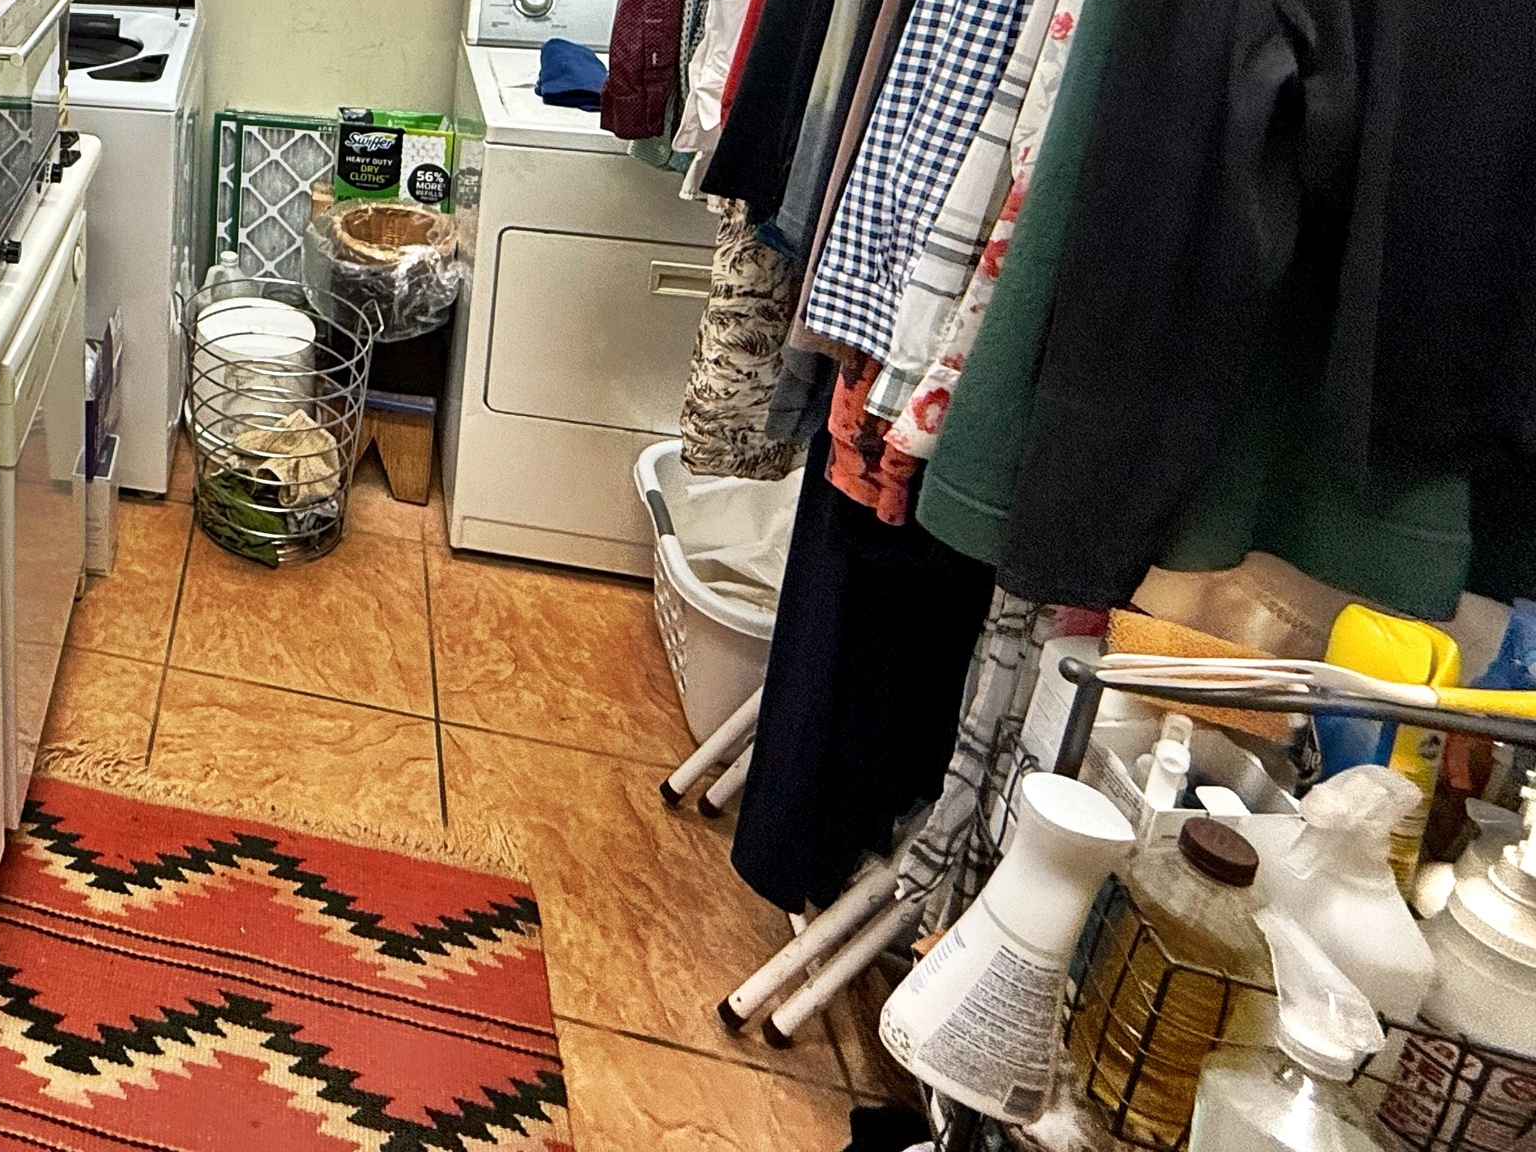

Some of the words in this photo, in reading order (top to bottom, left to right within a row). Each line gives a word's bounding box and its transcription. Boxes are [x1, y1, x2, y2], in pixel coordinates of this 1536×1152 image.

[345, 132, 396, 151] Swiffer
[346, 155, 370, 164] HEAVY
[372, 157, 393, 166] DUTY
[360, 164, 379, 174] DRY
[350, 171, 386, 184] CLOTHS
[416, 170, 444, 183] 56%
